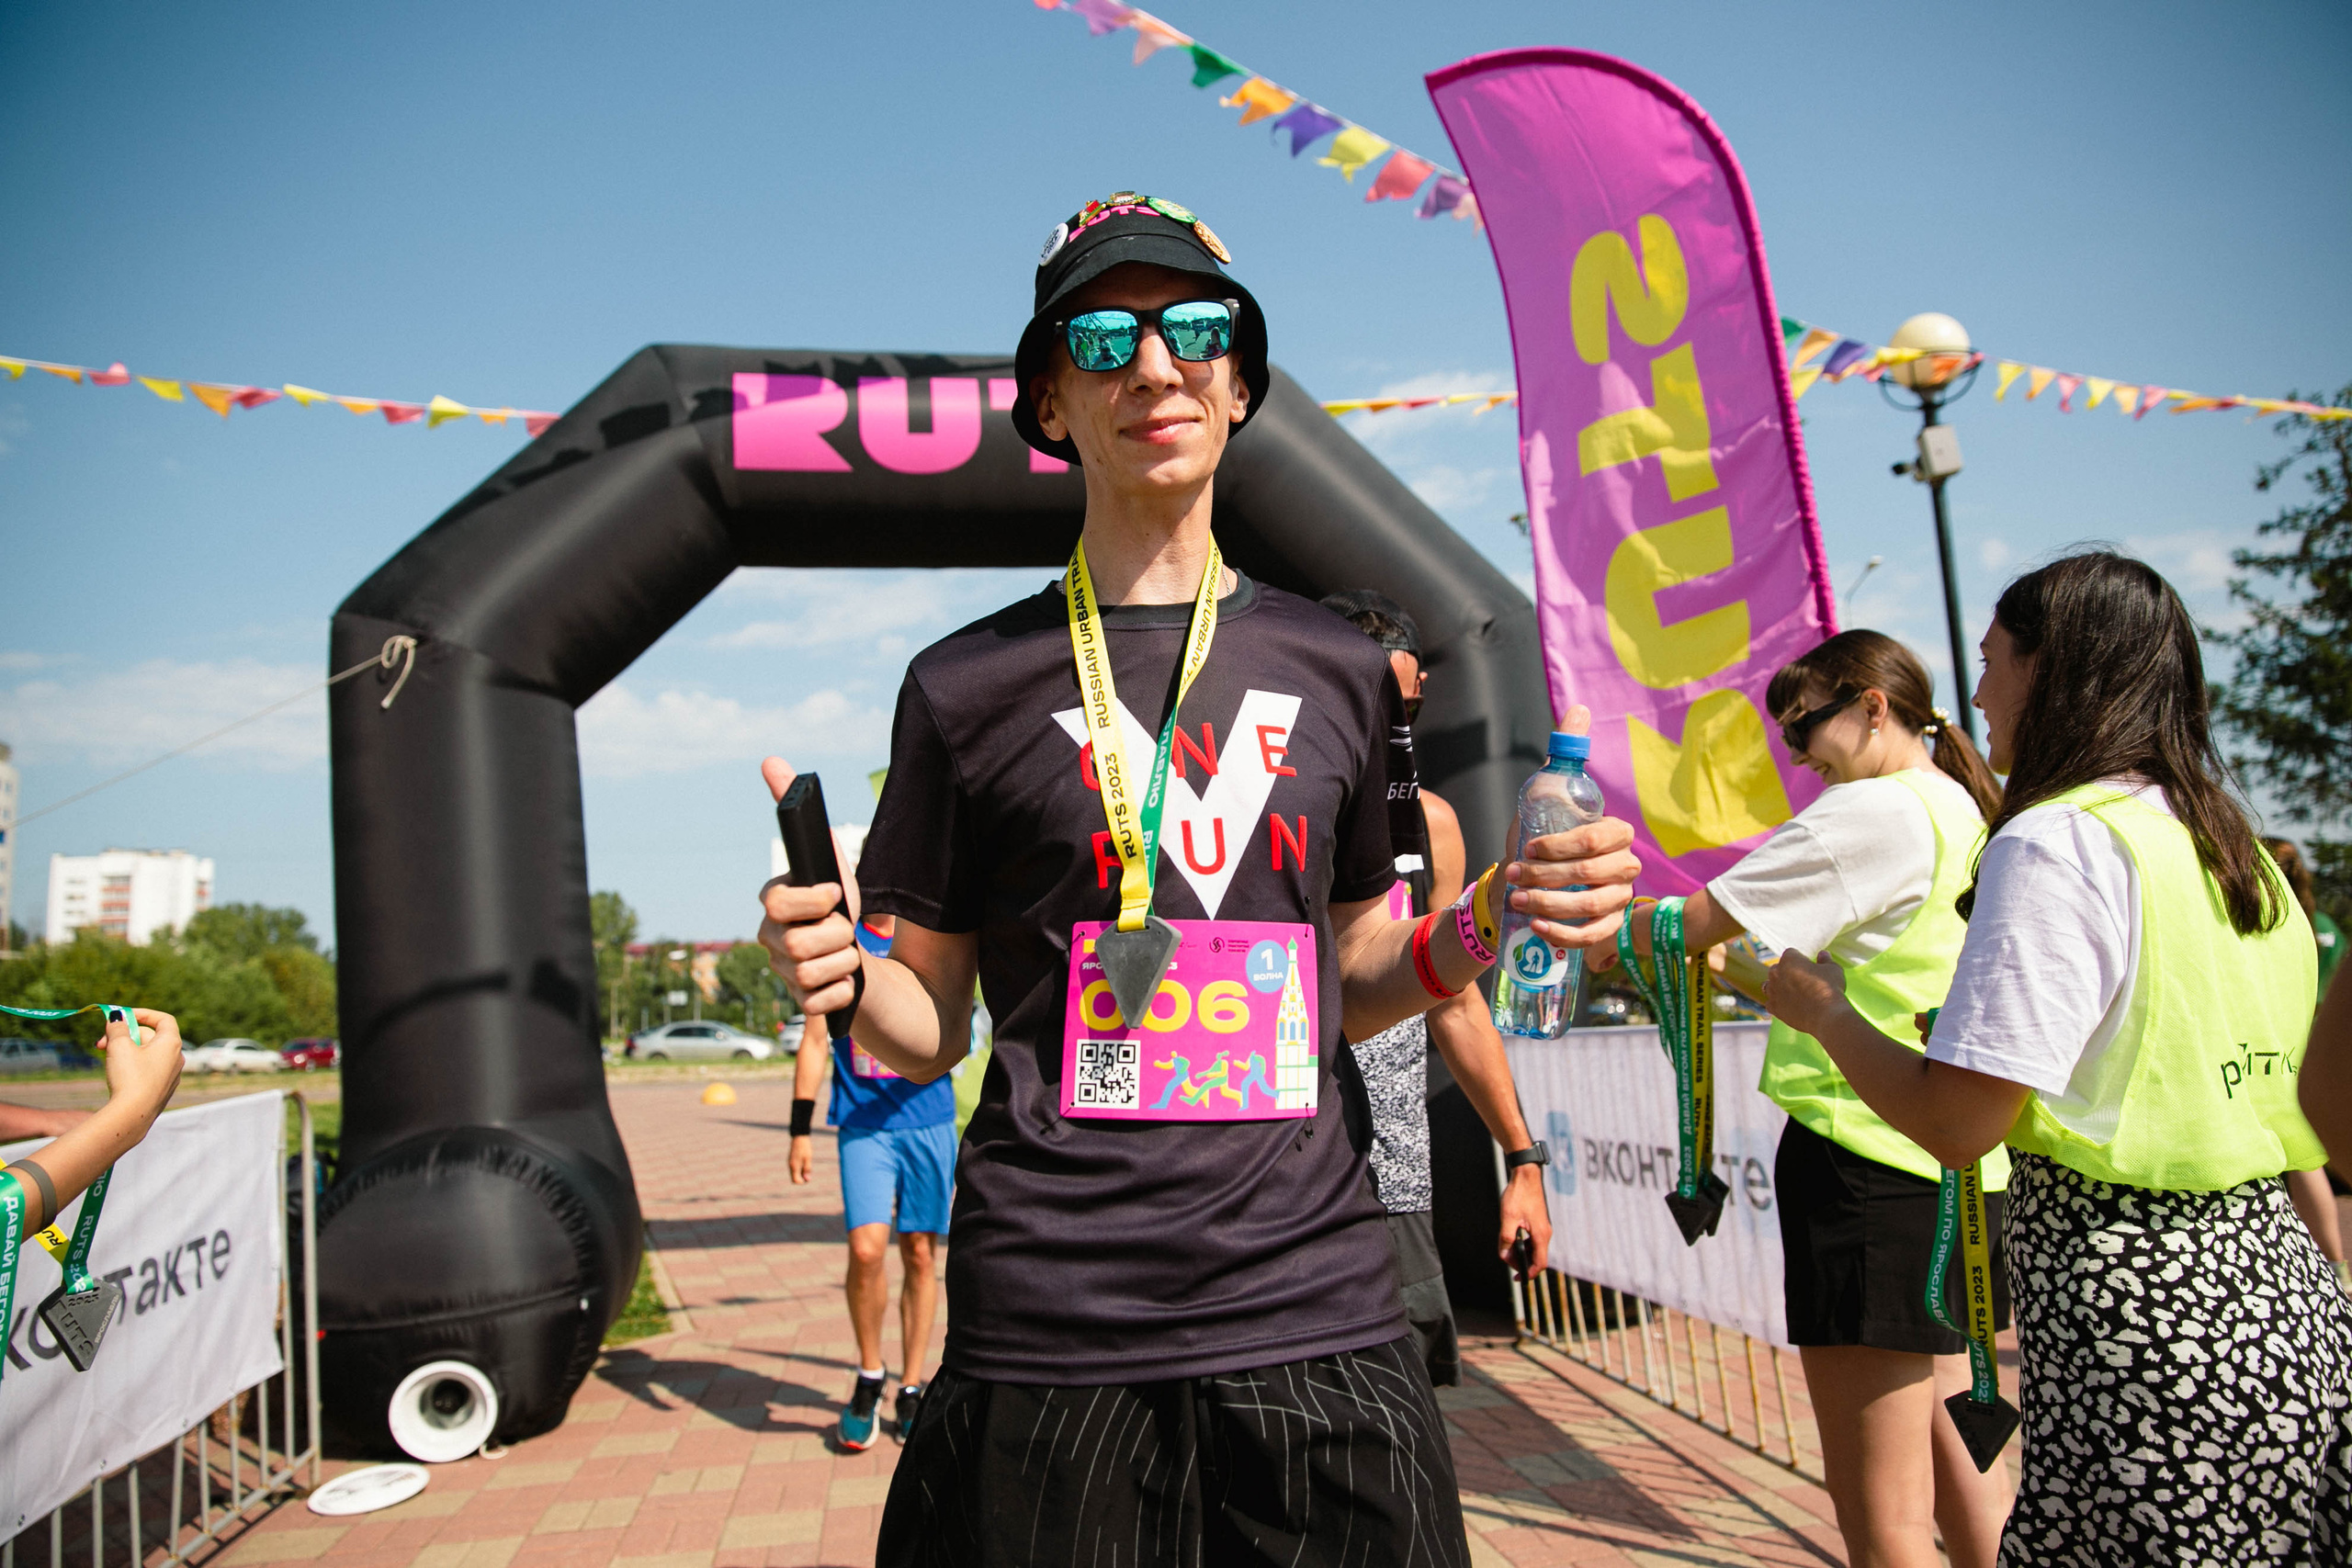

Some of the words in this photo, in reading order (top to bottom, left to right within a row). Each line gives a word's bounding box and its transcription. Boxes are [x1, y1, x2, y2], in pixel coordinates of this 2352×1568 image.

[1570, 212, 1792, 857] RUTS
[1075, 586, 1094, 646] URBAN
[1191, 609, 1213, 668] URBAN
[1087, 648, 1111, 730] RUSSIAN
[1106, 752, 1125, 800] 2023
[1114, 805, 1137, 860] RUTS
[1459, 904, 1495, 962] RUTS
[1252, 972, 1284, 981] ВОЛНА
[1261, 948, 1273, 970] 1
[1696, 962, 1706, 1004] URBAN
[1080, 979, 1250, 1034] 006
[1695, 1006, 1705, 1040] TRAIL
[1680, 1030, 1688, 1048] ПО
[1680, 1050, 1690, 1091] БЕГОМ
[1695, 1043, 1704, 1084] SERIES
[1682, 1092, 1692, 1135] ДАВАЙ
[1942, 1168, 1956, 1215] ЕГОМ
[1967, 1172, 1981, 1246] RUSSIAN
[2, 1195, 18, 1269] ДАВАЙ
[73, 1214, 95, 1260] RUTS
[1940, 1215, 1954, 1241] ПО
[1972, 1265, 1986, 1304] 2023
